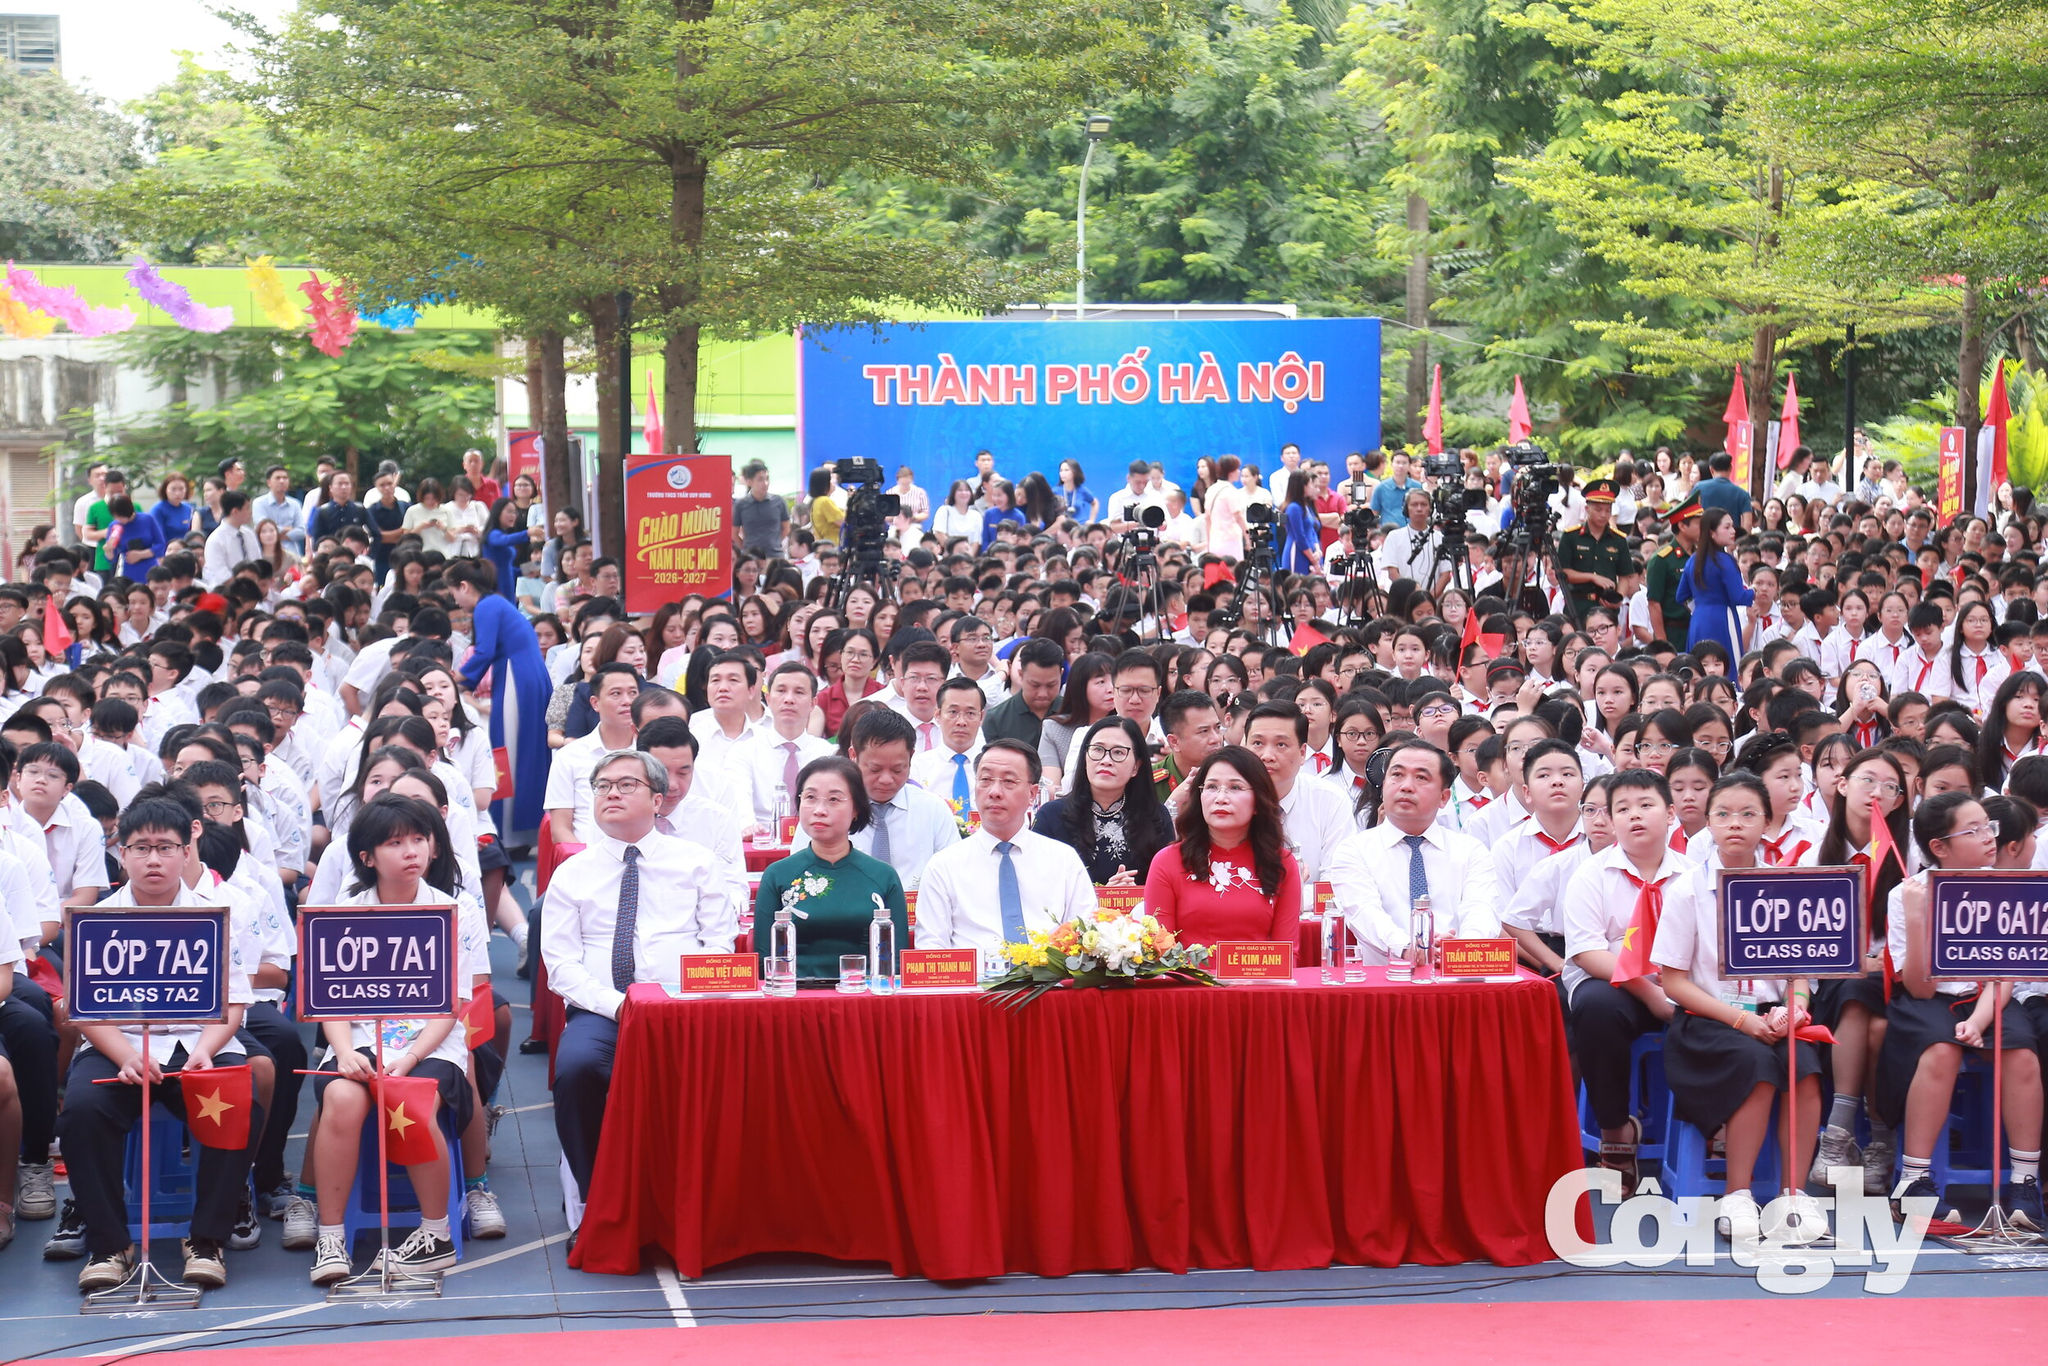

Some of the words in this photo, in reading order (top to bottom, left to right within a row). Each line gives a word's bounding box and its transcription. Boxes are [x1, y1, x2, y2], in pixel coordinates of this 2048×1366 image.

[863, 353, 1035, 405] THÀNH
[1045, 347, 1151, 405] PHỐ
[1158, 351, 1230, 404] HÀ
[1237, 351, 1325, 414] NỘI
[638, 511, 679, 547] CHÀO
[680, 505, 722, 537] MỪNG
[675, 548, 696, 573] HỌC
[697, 543, 719, 570] MỚI
[1735, 889, 1791, 933] LỚP
[1797, 897, 1847, 932] 6A9
[1941, 891, 1991, 935] LỚP
[85, 930, 147, 976] LỚP
[156, 939, 209, 975] 7A2
[319, 927, 379, 972] LỚP
[387, 936, 436, 971] 7A1
[1227, 952, 1239, 965] LÊ
[1241, 954, 1260, 965] KIM
[1261, 954, 1282, 965] ANH
[1744, 944, 1803, 959] CLASS
[1806, 943, 1839, 958] 6A9
[1945, 946, 2003, 960] CLASS
[2007, 946, 2048, 961] 6A12
[906, 962, 925, 976] PHẠM
[926, 962, 937, 975] THỊ
[937, 961, 958, 973] THANH
[958, 961, 972, 972] MAI
[93, 987, 159, 1003] CLASS
[164, 987, 199, 1002] 7A2
[328, 983, 391, 999] CLASS
[396, 983, 429, 998] 7A1
